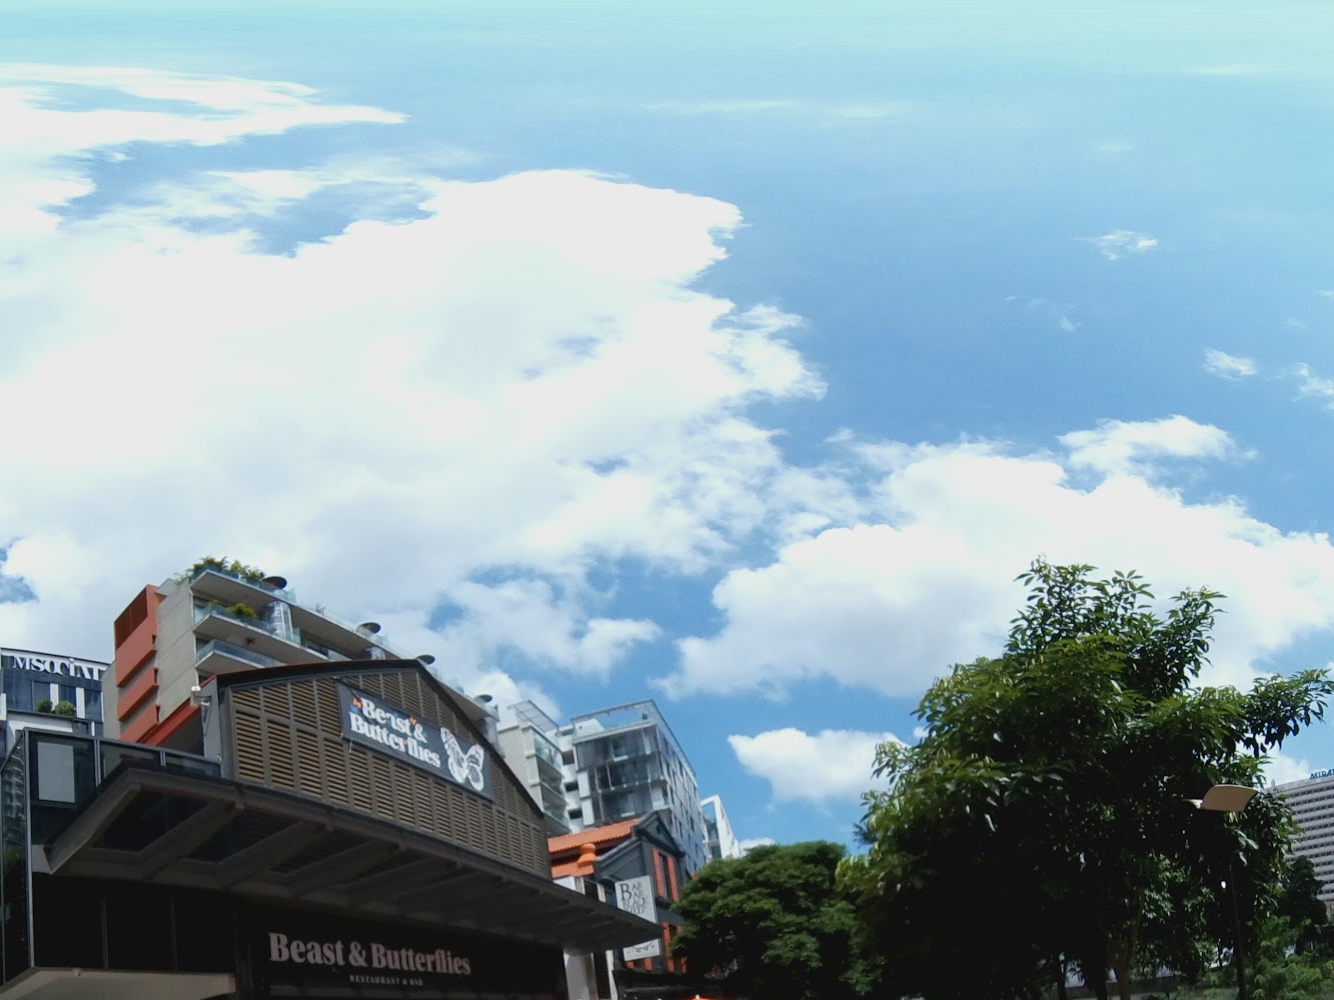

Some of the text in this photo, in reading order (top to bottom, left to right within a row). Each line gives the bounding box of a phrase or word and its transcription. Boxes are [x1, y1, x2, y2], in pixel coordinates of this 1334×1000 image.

[349, 711, 442, 768] Butterflies
[360, 697, 428, 744] Beast &
[267, 932, 472, 976] Beast & Butterflies
[349, 974, 400, 985] RESTAURANT
